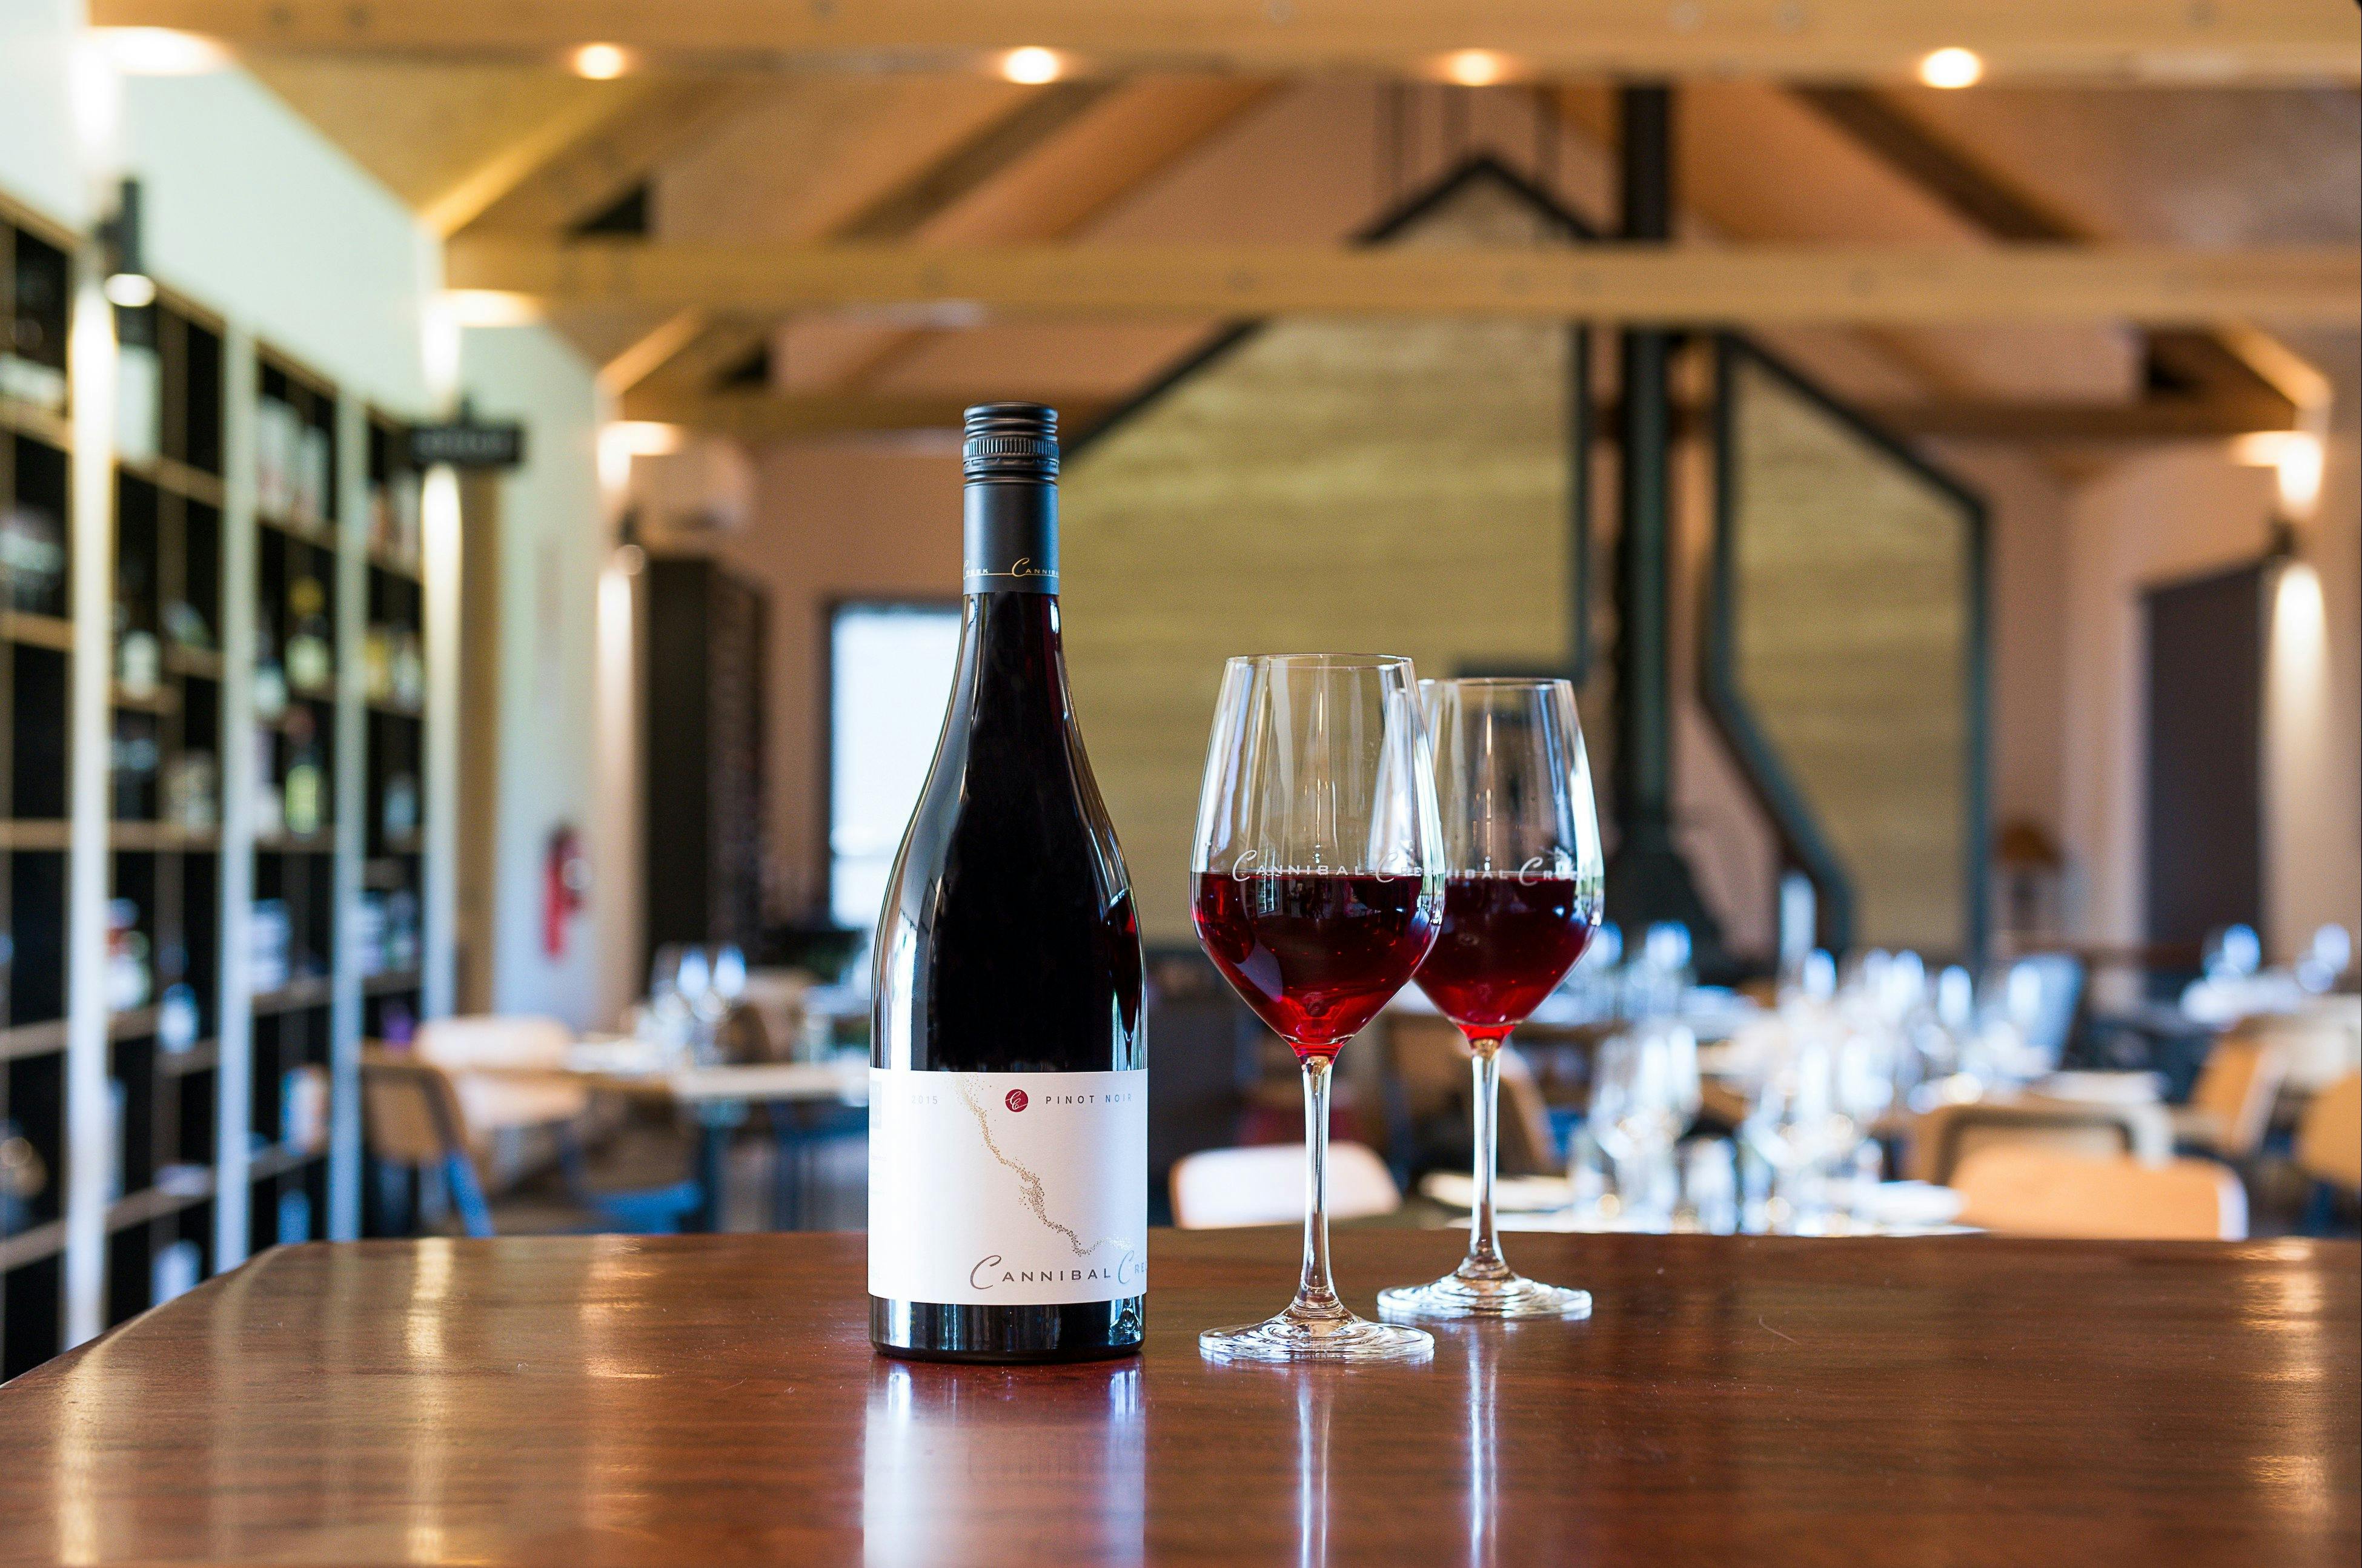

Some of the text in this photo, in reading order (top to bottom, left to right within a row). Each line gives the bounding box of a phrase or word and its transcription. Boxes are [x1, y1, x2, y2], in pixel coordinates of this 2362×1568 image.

[1232, 850, 1364, 882] CANNIBAL
[911, 1094, 938, 1105] 2015
[1046, 1093, 1133, 1105] PINOT NOIR
[969, 1254, 1111, 1290] CANNIBAL
